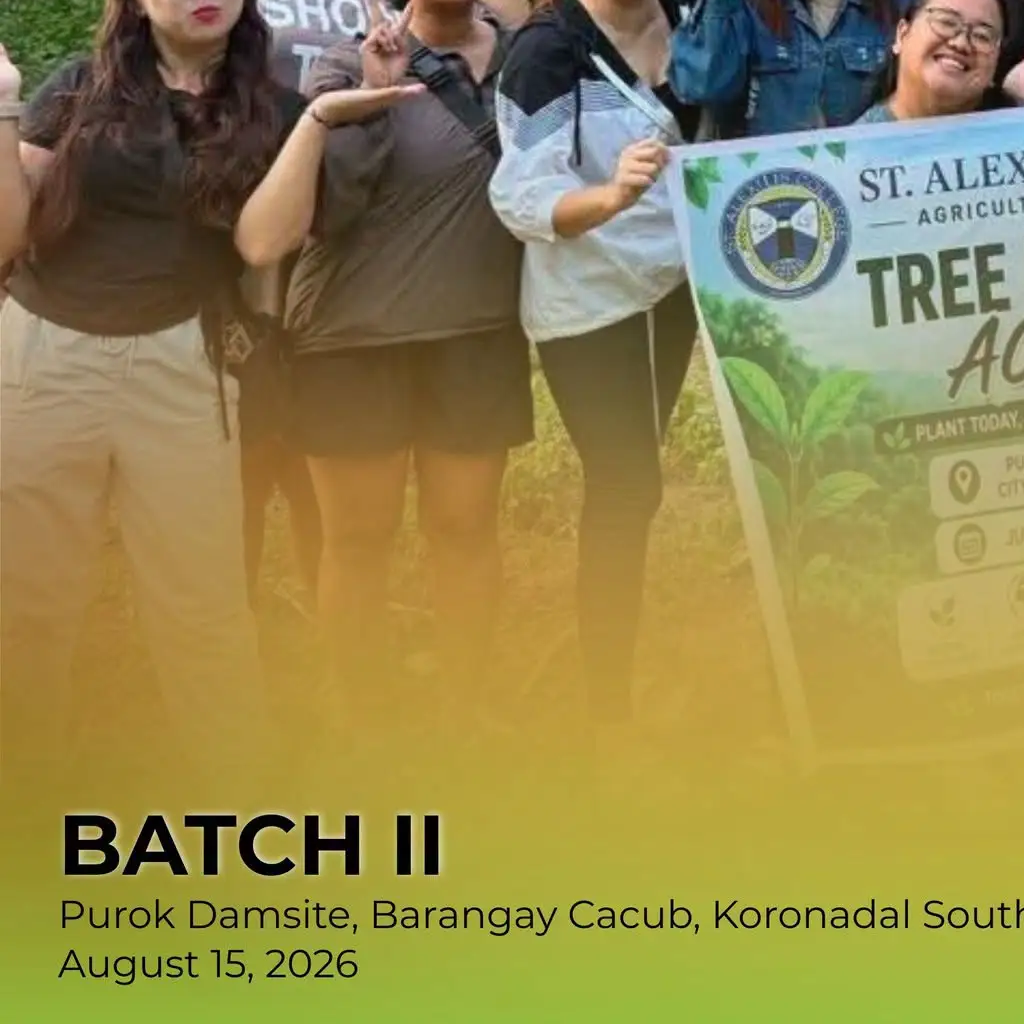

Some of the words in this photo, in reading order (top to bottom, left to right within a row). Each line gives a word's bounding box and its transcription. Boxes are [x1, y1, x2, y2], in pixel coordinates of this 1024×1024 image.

[859, 165, 913, 203] ST.
[856, 242, 1011, 328] TREE
[915, 418, 968, 442] PLANT
[969, 408, 1023, 434] TODAY,
